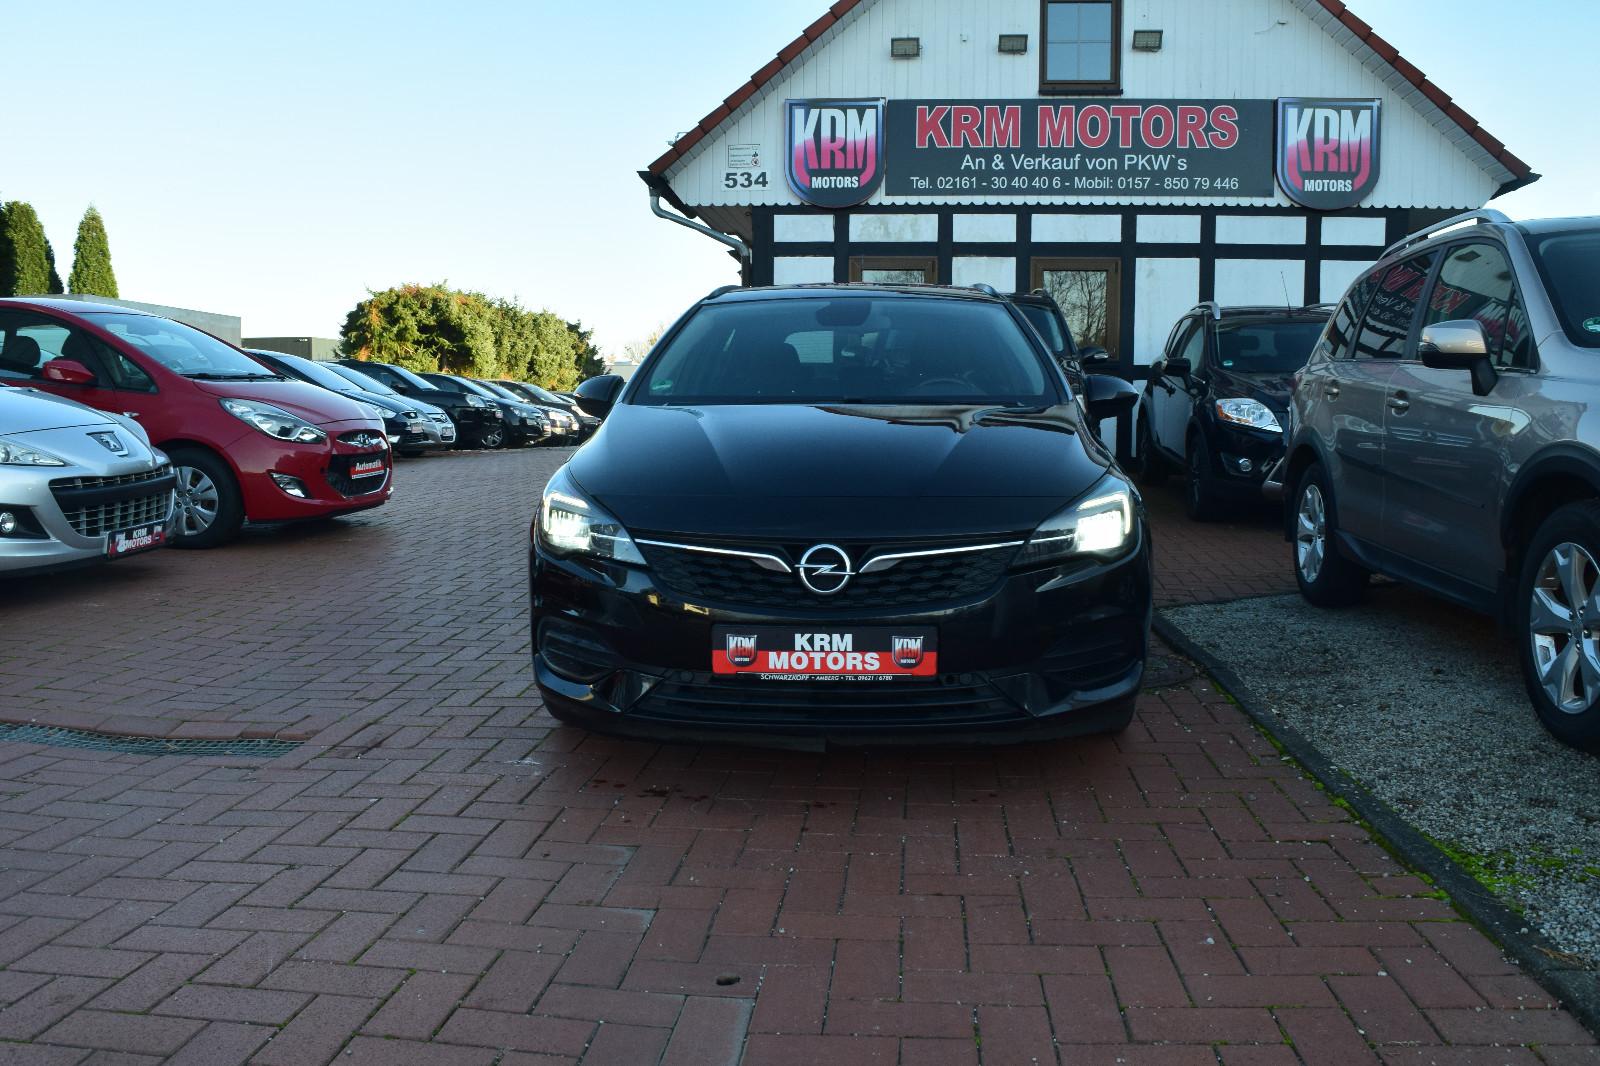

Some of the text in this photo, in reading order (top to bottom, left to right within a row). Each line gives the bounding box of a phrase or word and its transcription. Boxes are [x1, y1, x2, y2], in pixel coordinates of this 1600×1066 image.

[916, 104, 1239, 149] KRM MOTORS
[794, 108, 876, 181] KRM
[1287, 108, 1371, 183] KRM
[961, 154, 986, 170] An
[992, 154, 1004, 170] &
[1011, 154, 1081, 170] Verkauf
[1086, 158, 1118, 170] von
[724, 172, 768, 188] 534
[812, 176, 859, 189] MOTORS
[910, 177, 932, 189] Tel.
[937, 177, 976, 189] 02161
[991, 177, 1008, 189] 30
[1012, 177, 1028, 189] 40
[1032, 177, 1048, 189] 40
[1052, 177, 1061, 189] 6
[1074, 177, 1113, 189] Mobil:
[1118, 177, 1150, 189] 0157
[1164, 178, 1188, 189] 850
[1193, 178, 1210, 189] 79
[1214, 178, 1239, 189] 446
[1304, 180, 1352, 192] MOTORS
[794, 633, 852, 651] KRM
[768, 652, 880, 670] MOTORS
